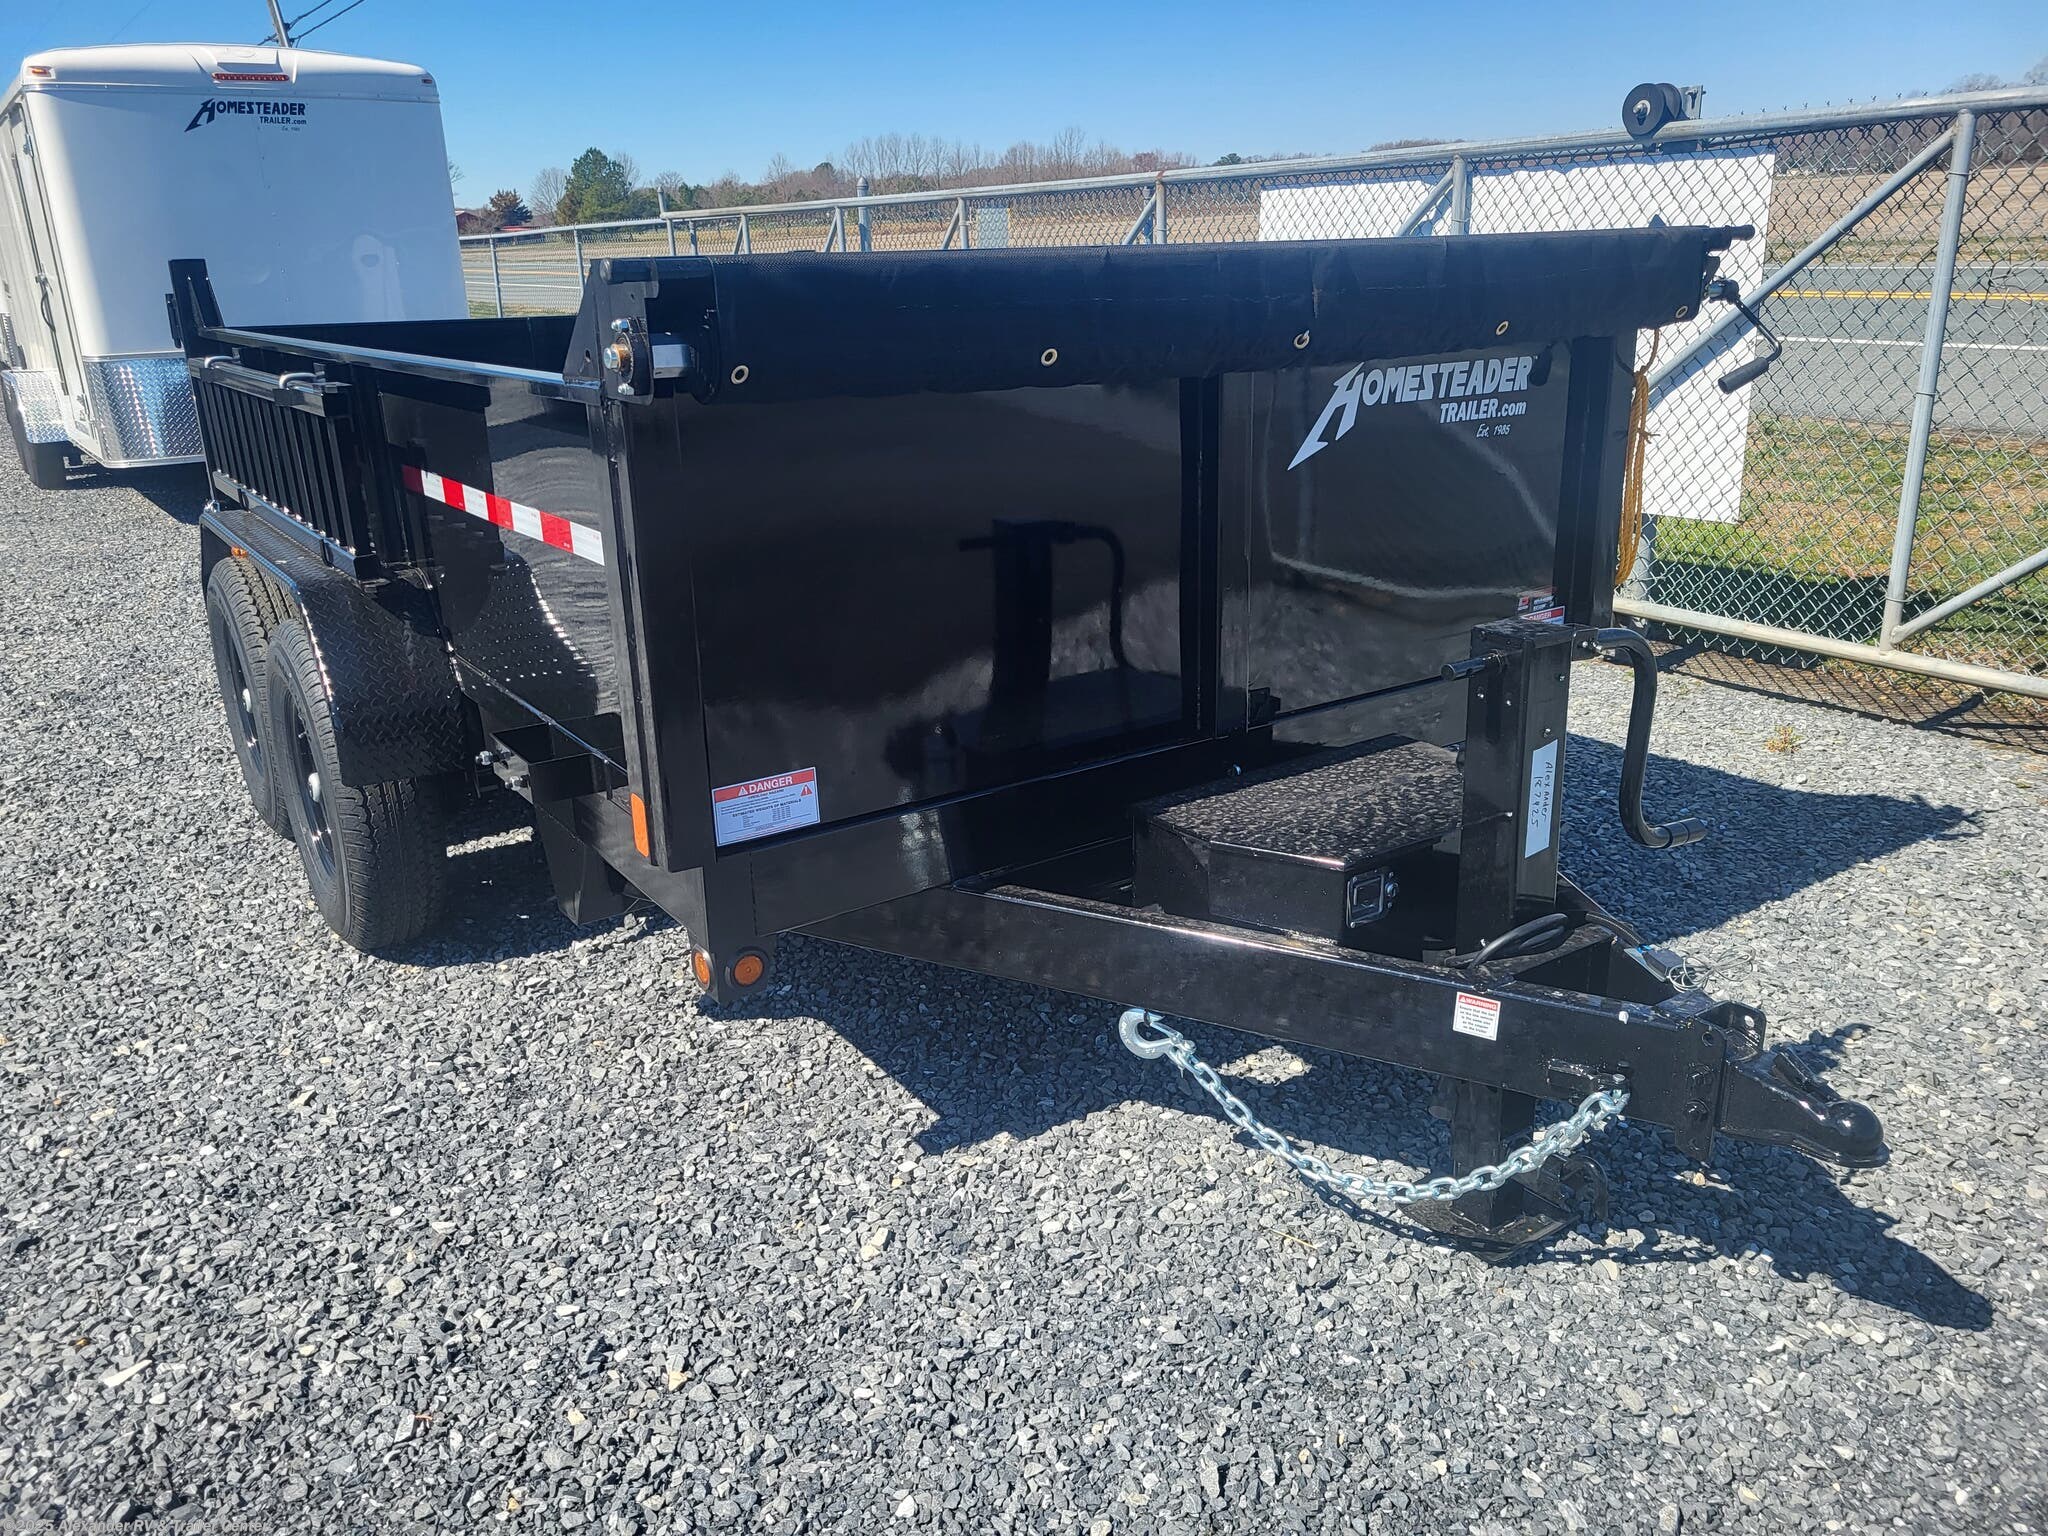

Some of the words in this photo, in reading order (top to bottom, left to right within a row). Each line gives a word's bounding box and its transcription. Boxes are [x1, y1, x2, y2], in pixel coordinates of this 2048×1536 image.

[184, 98, 306, 132] HOMESTEADER
[1288, 356, 1533, 470] HOMESTEADER
[1494, 424, 1511, 436] 1985
[748, 775, 793, 794] DANGER
[1465, 999, 1498, 1010] WARNING
